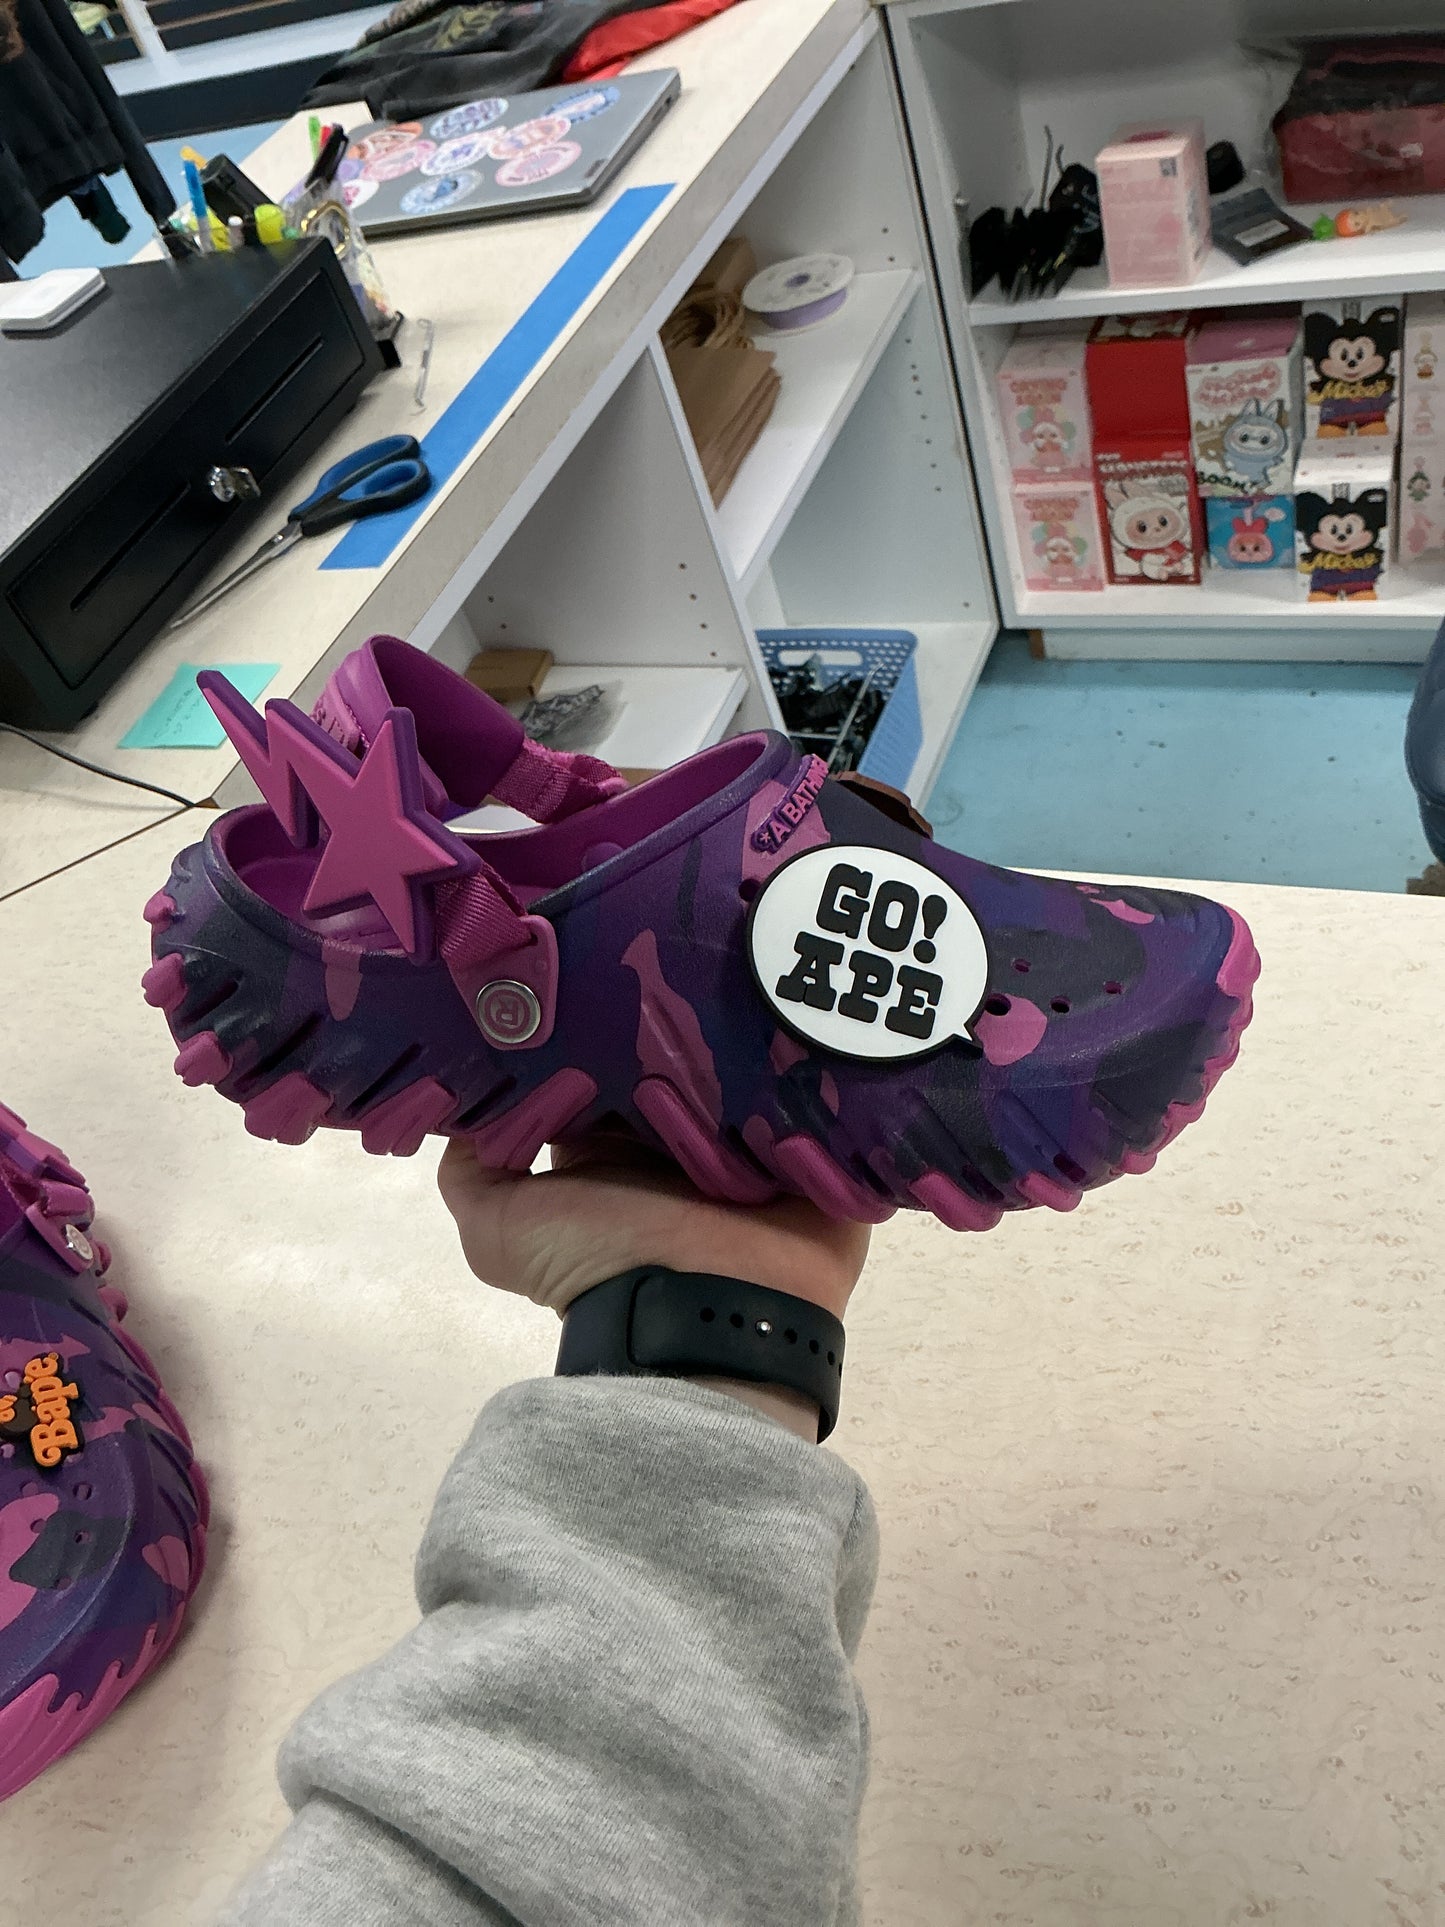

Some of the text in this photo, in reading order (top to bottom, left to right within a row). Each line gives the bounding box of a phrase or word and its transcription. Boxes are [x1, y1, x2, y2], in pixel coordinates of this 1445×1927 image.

[815, 862, 948, 964] GO!
[775, 931, 943, 1040] APE
[23, 1352, 79, 1467] Bape
